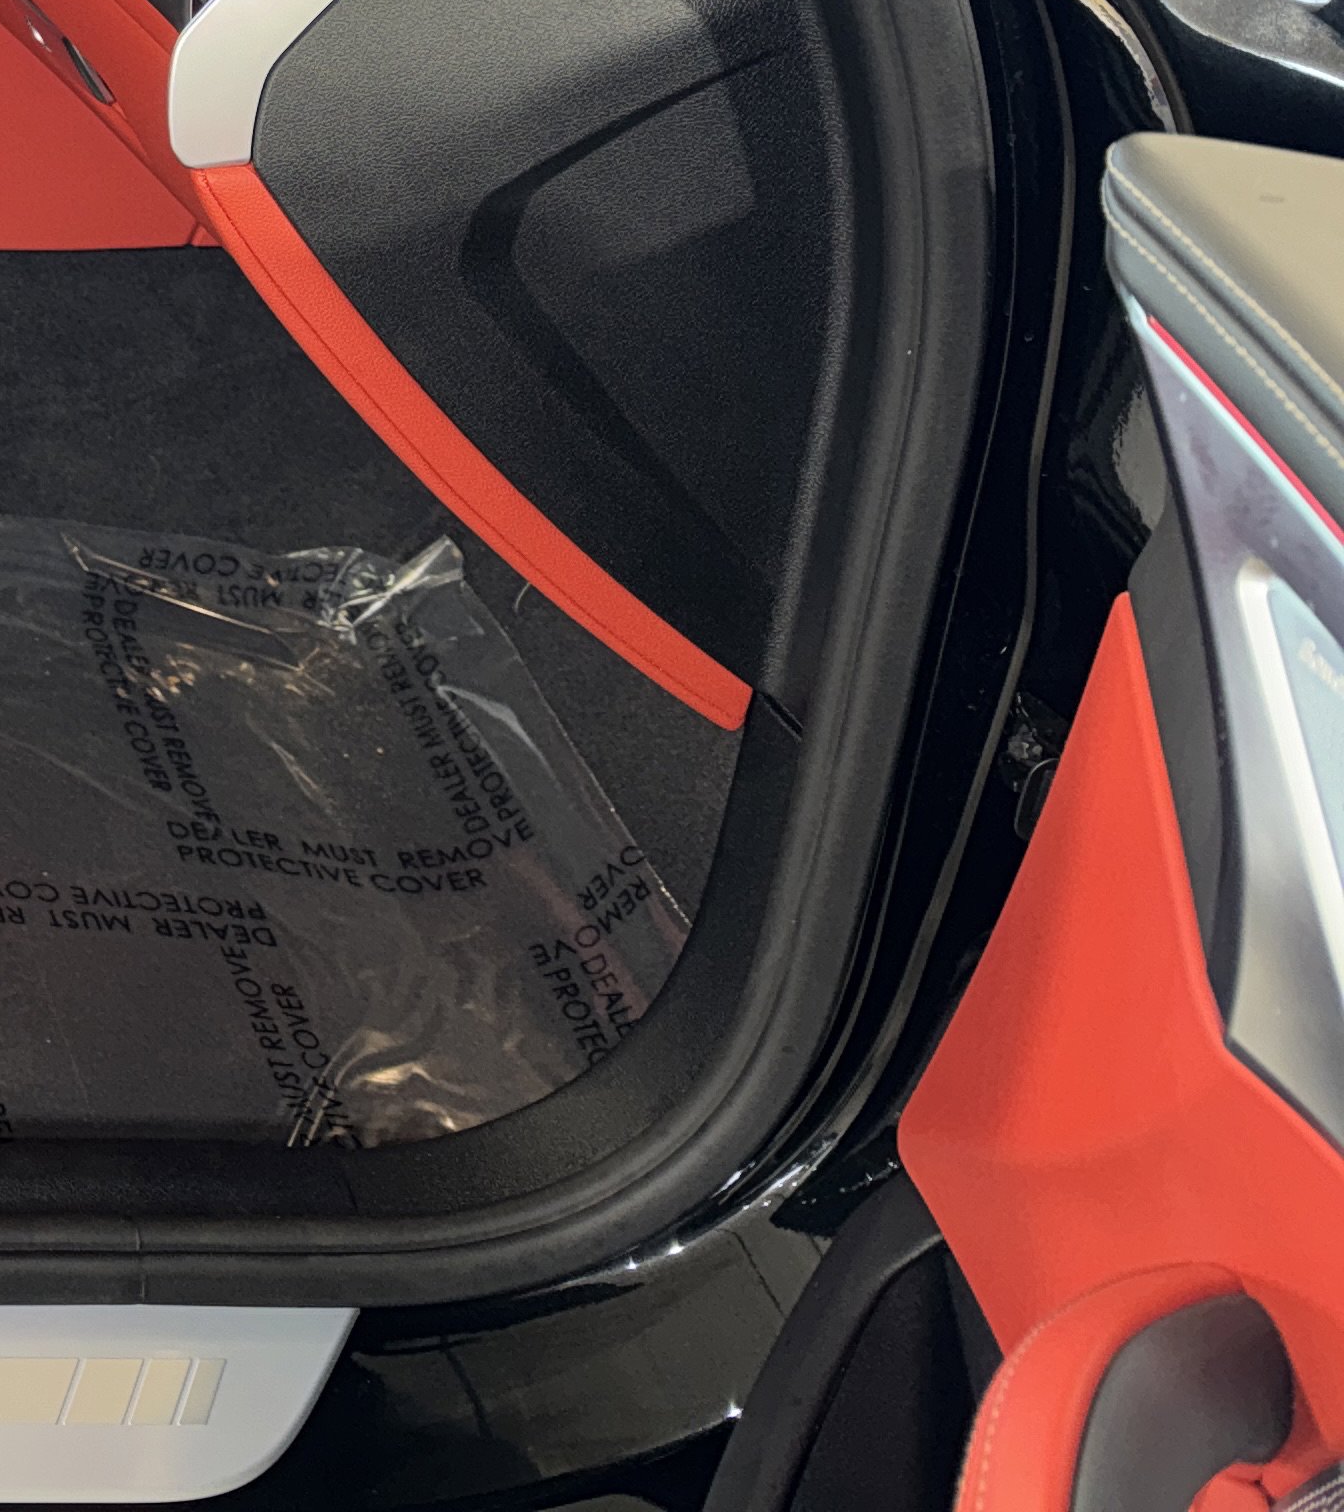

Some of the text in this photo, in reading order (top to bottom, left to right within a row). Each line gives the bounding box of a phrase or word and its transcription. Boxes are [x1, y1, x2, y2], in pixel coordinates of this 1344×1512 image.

[139, 547, 241, 578] COVER
[399, 695, 445, 749] MUST
[124, 718, 173, 793] COVER
[162, 737, 221, 825] REMOVE
[428, 751, 490, 835] DEALER
[166, 819, 535, 871] DEALER MUST REMOVE
[177, 844, 489, 895] PROTECTIVE COVER
[49, 909, 131, 934] MUST
[71, 885, 268, 921] PROTECTIVE
[154, 918, 278, 948] DEALER
[220, 945, 287, 1052] REMOVE
[271, 982, 331, 1069] COVER
